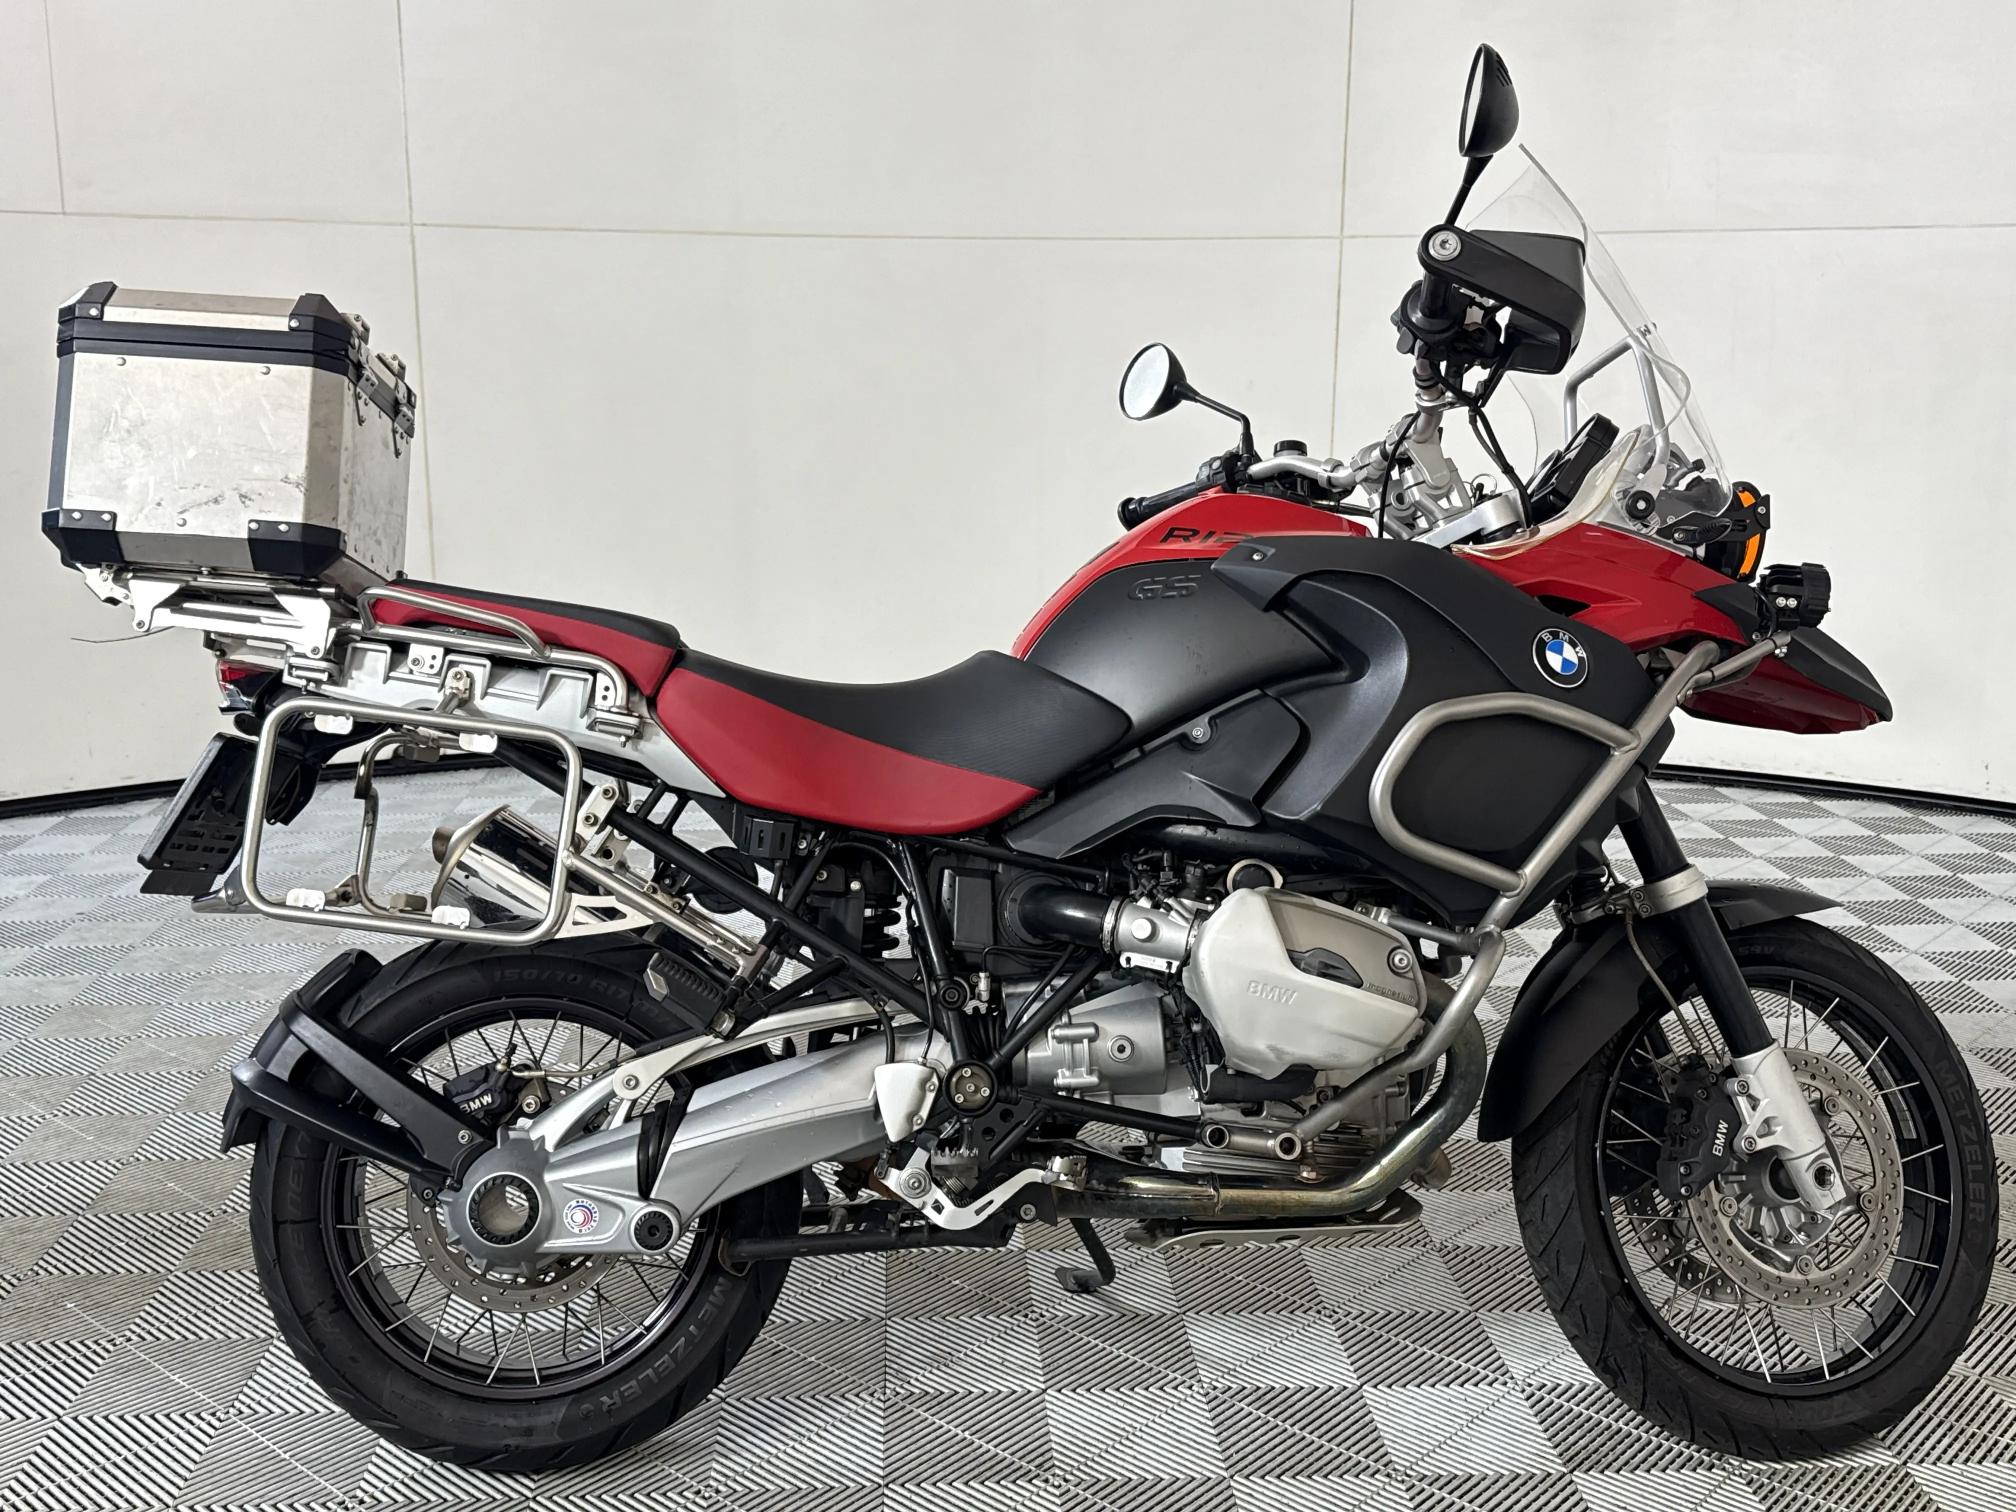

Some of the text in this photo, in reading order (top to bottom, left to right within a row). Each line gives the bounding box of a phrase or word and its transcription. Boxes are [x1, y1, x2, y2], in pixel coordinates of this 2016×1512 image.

[1127, 573, 1202, 601] GS
[1541, 631, 1586, 658] BMW
[1247, 979, 1298, 1006] BMW
[459, 1092, 493, 1115] BMW
[1711, 1119, 1730, 1157] BMW
[1933, 1056, 1987, 1225] METZELER
[598, 1275, 733, 1416] METZELER
